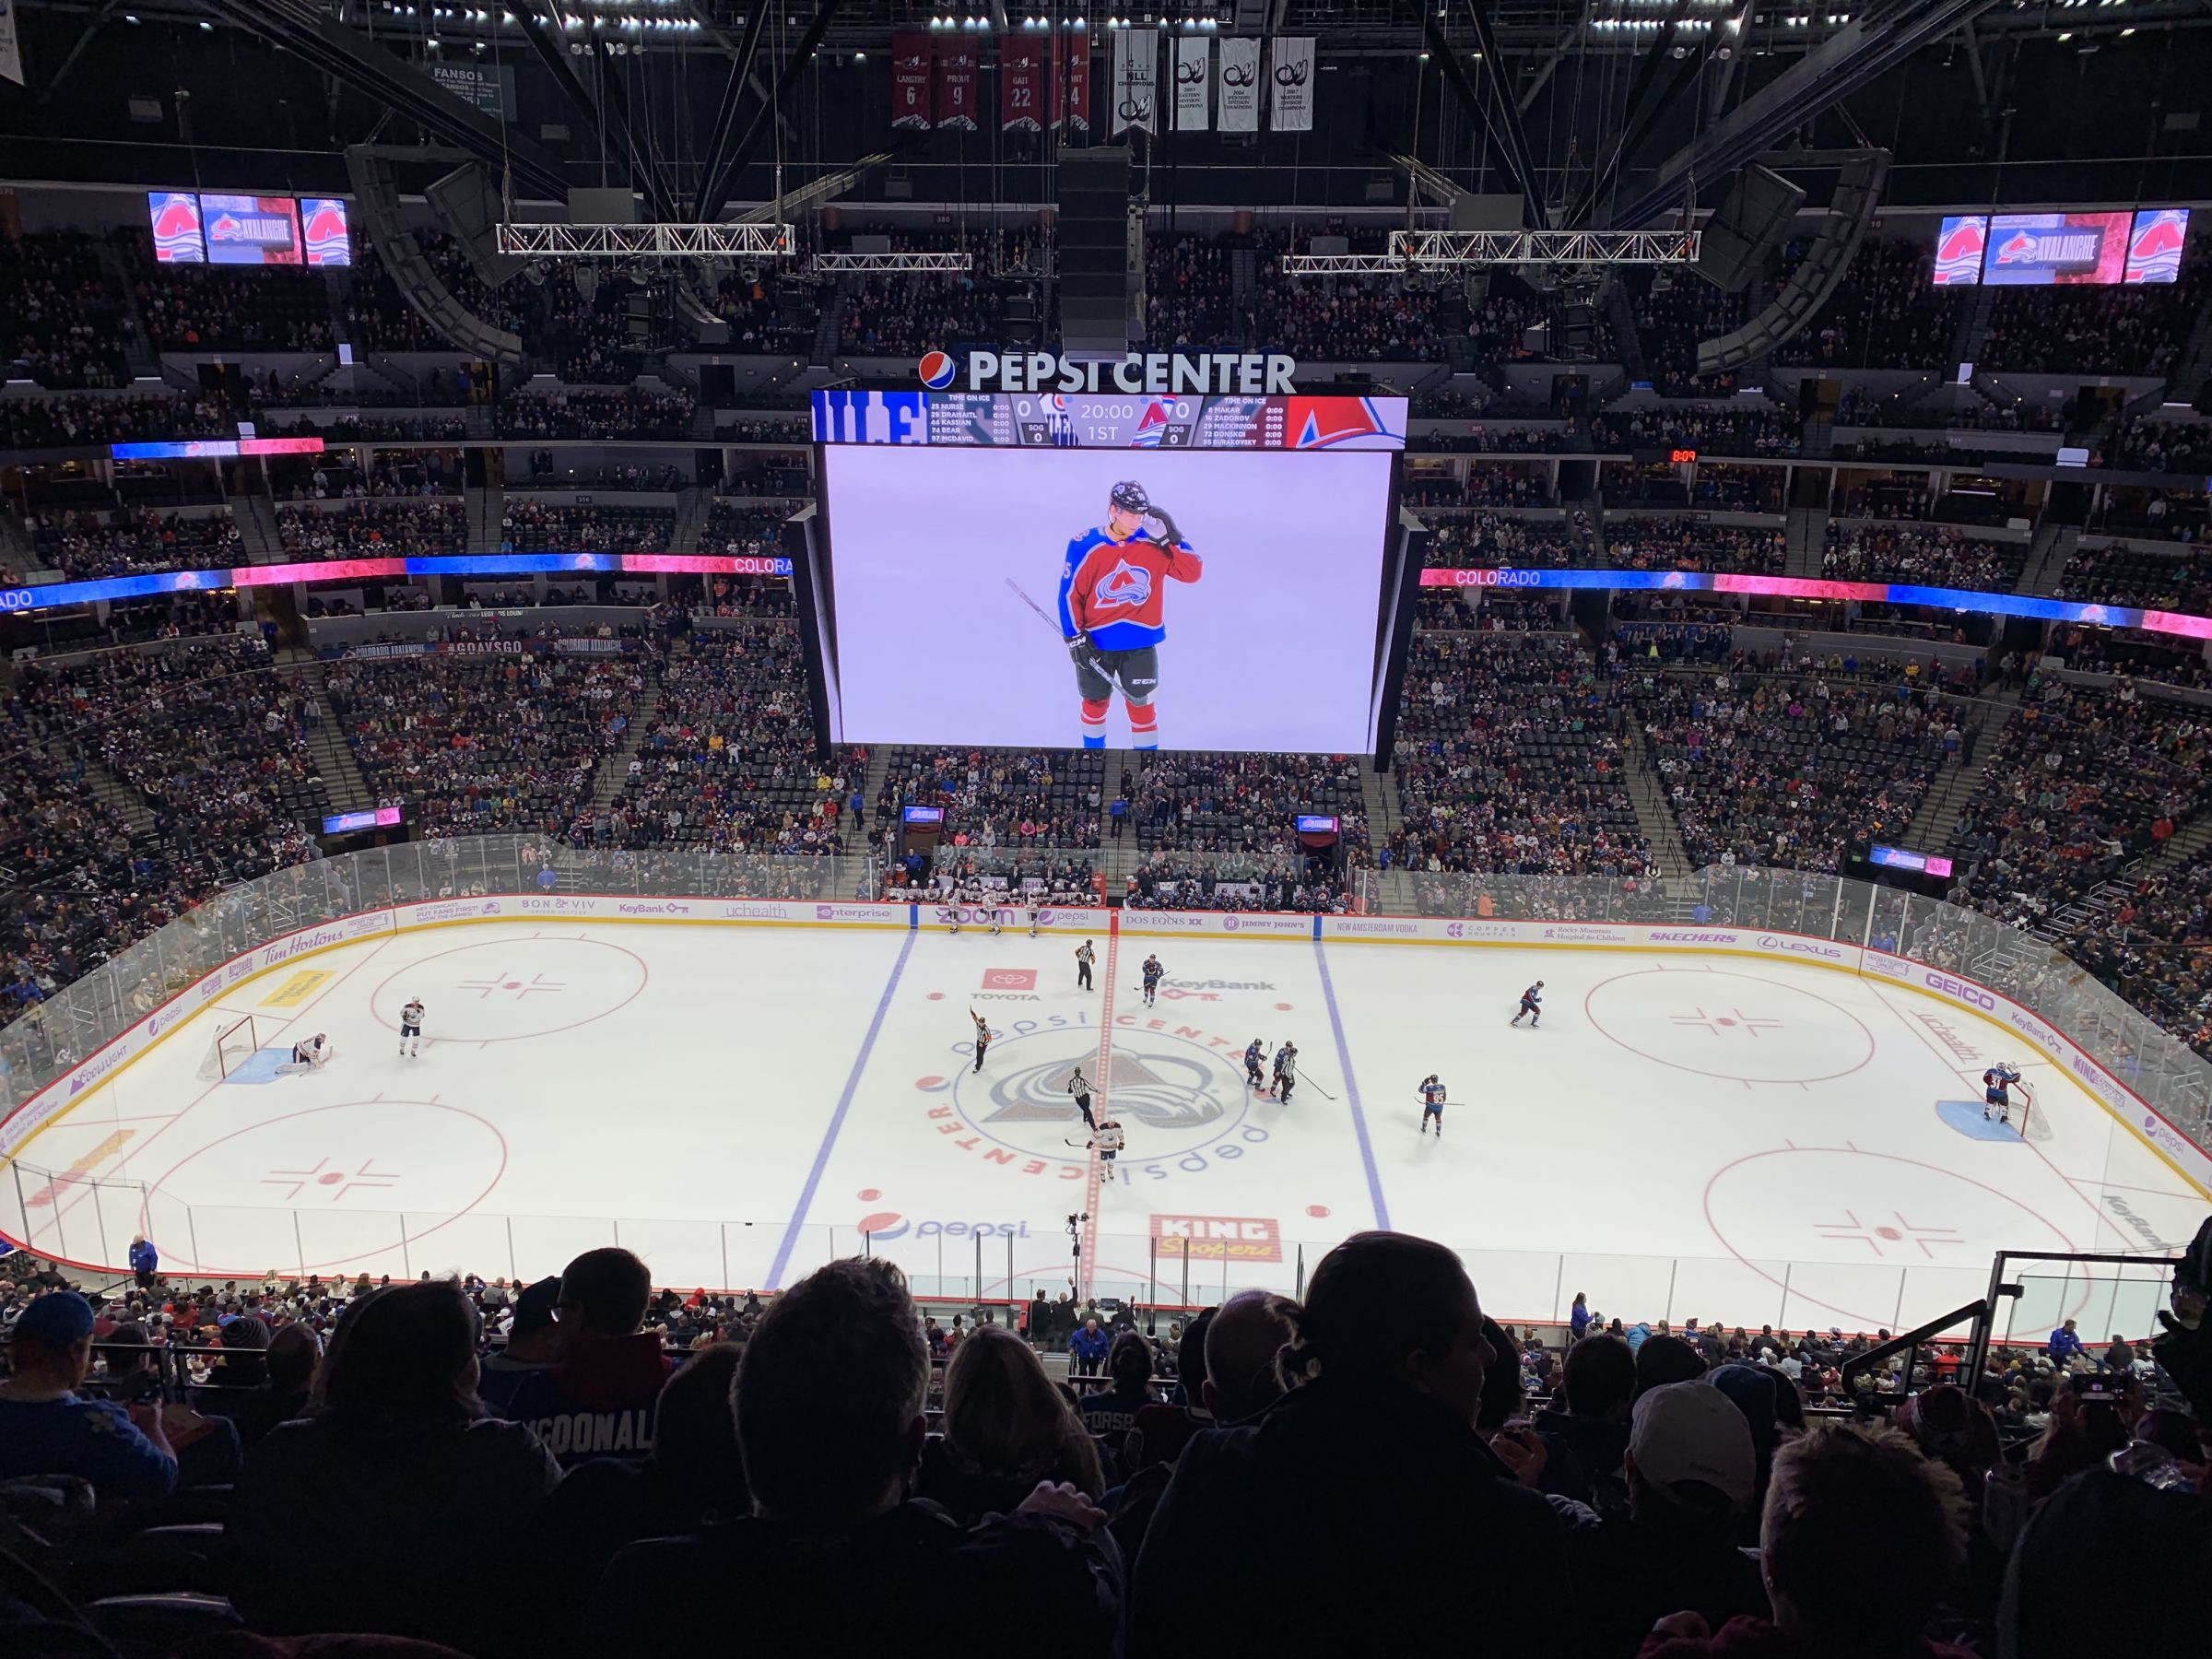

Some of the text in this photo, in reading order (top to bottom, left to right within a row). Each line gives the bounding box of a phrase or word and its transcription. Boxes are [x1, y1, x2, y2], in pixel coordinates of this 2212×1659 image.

[434, 68, 483, 81] FANSOS
[897, 75, 925, 83] LANGTRY
[947, 75, 970, 83] PROUT
[1012, 76, 1028, 85] GAIT
[906, 87, 915, 105] 6
[953, 87, 962, 105] 9
[1011, 88, 1030, 107] 22
[241, 218, 290, 241] AVALANCHE
[2037, 234, 2099, 261] AVALANCHE
[970, 351, 1298, 394] PEPSI CENTER
[1018, 401, 1031, 418] 0
[1081, 405, 1133, 419] 20:00
[1176, 402, 1190, 418] 0
[1088, 426, 1119, 441] 1ST
[1169, 426, 1184, 434] SOG
[1265, 423, 1282, 431] 0:00
[1034, 433, 1042, 443] 0
[1170, 434, 1179, 444] 0
[1265, 430, 1282, 439] 0:00
[1265, 439, 1281, 447] 0:00
[1673, 451, 1695, 462] 8:09
[1456, 571, 1541, 585] COLORADO
[356, 642, 425, 657] COLORADO AVALANCHE
[590, 639, 622, 653] AVALANCHE
[523, 899, 595, 909] BON & VIV
[619, 904, 665, 915] KeyBank
[725, 903, 787, 918] uchealth
[819, 908, 890, 919] enterprise
[937, 907, 1016, 925] zoom
[1057, 911, 1088, 921] pepsi
[1126, 916, 1148, 924] DOS
[1152, 916, 1185, 926] EQUIS
[1274, 921, 1305, 929] JOHN'S
[1337, 923, 1418, 933] NEW AMSTERDAM VODKA
[1557, 933, 1584, 941] Hospital
[1558, 926, 1575, 935] Rocky
[1649, 932, 1739, 943] SKECHERS
[263, 929, 343, 965] Tim Hortons
[1781, 941, 1841, 958] LEXUS
[1160, 979, 1276, 992] KeyBank
[1925, 972, 1994, 1011] GEICO
[971, 993, 1041, 1001] TOYOTA
[159, 1004, 182, 1026] pepsi
[952, 1011, 1095, 1057] pepsi
[2011, 1012, 2047, 1042] KeyBank
[1909, 1009, 1984, 1065] uchealth
[106, 1045, 128, 1069] LIGHT
[2073, 1054, 2096, 1085] KING
[926, 1106, 1268, 1185] pepsi CENTER
[2159, 1127, 2185, 1155] pepsi
[916, 1219, 1028, 1241] pepsi
[1156, 1219, 1269, 1240] KING
[1159, 1238, 1272, 1258] Soopers
